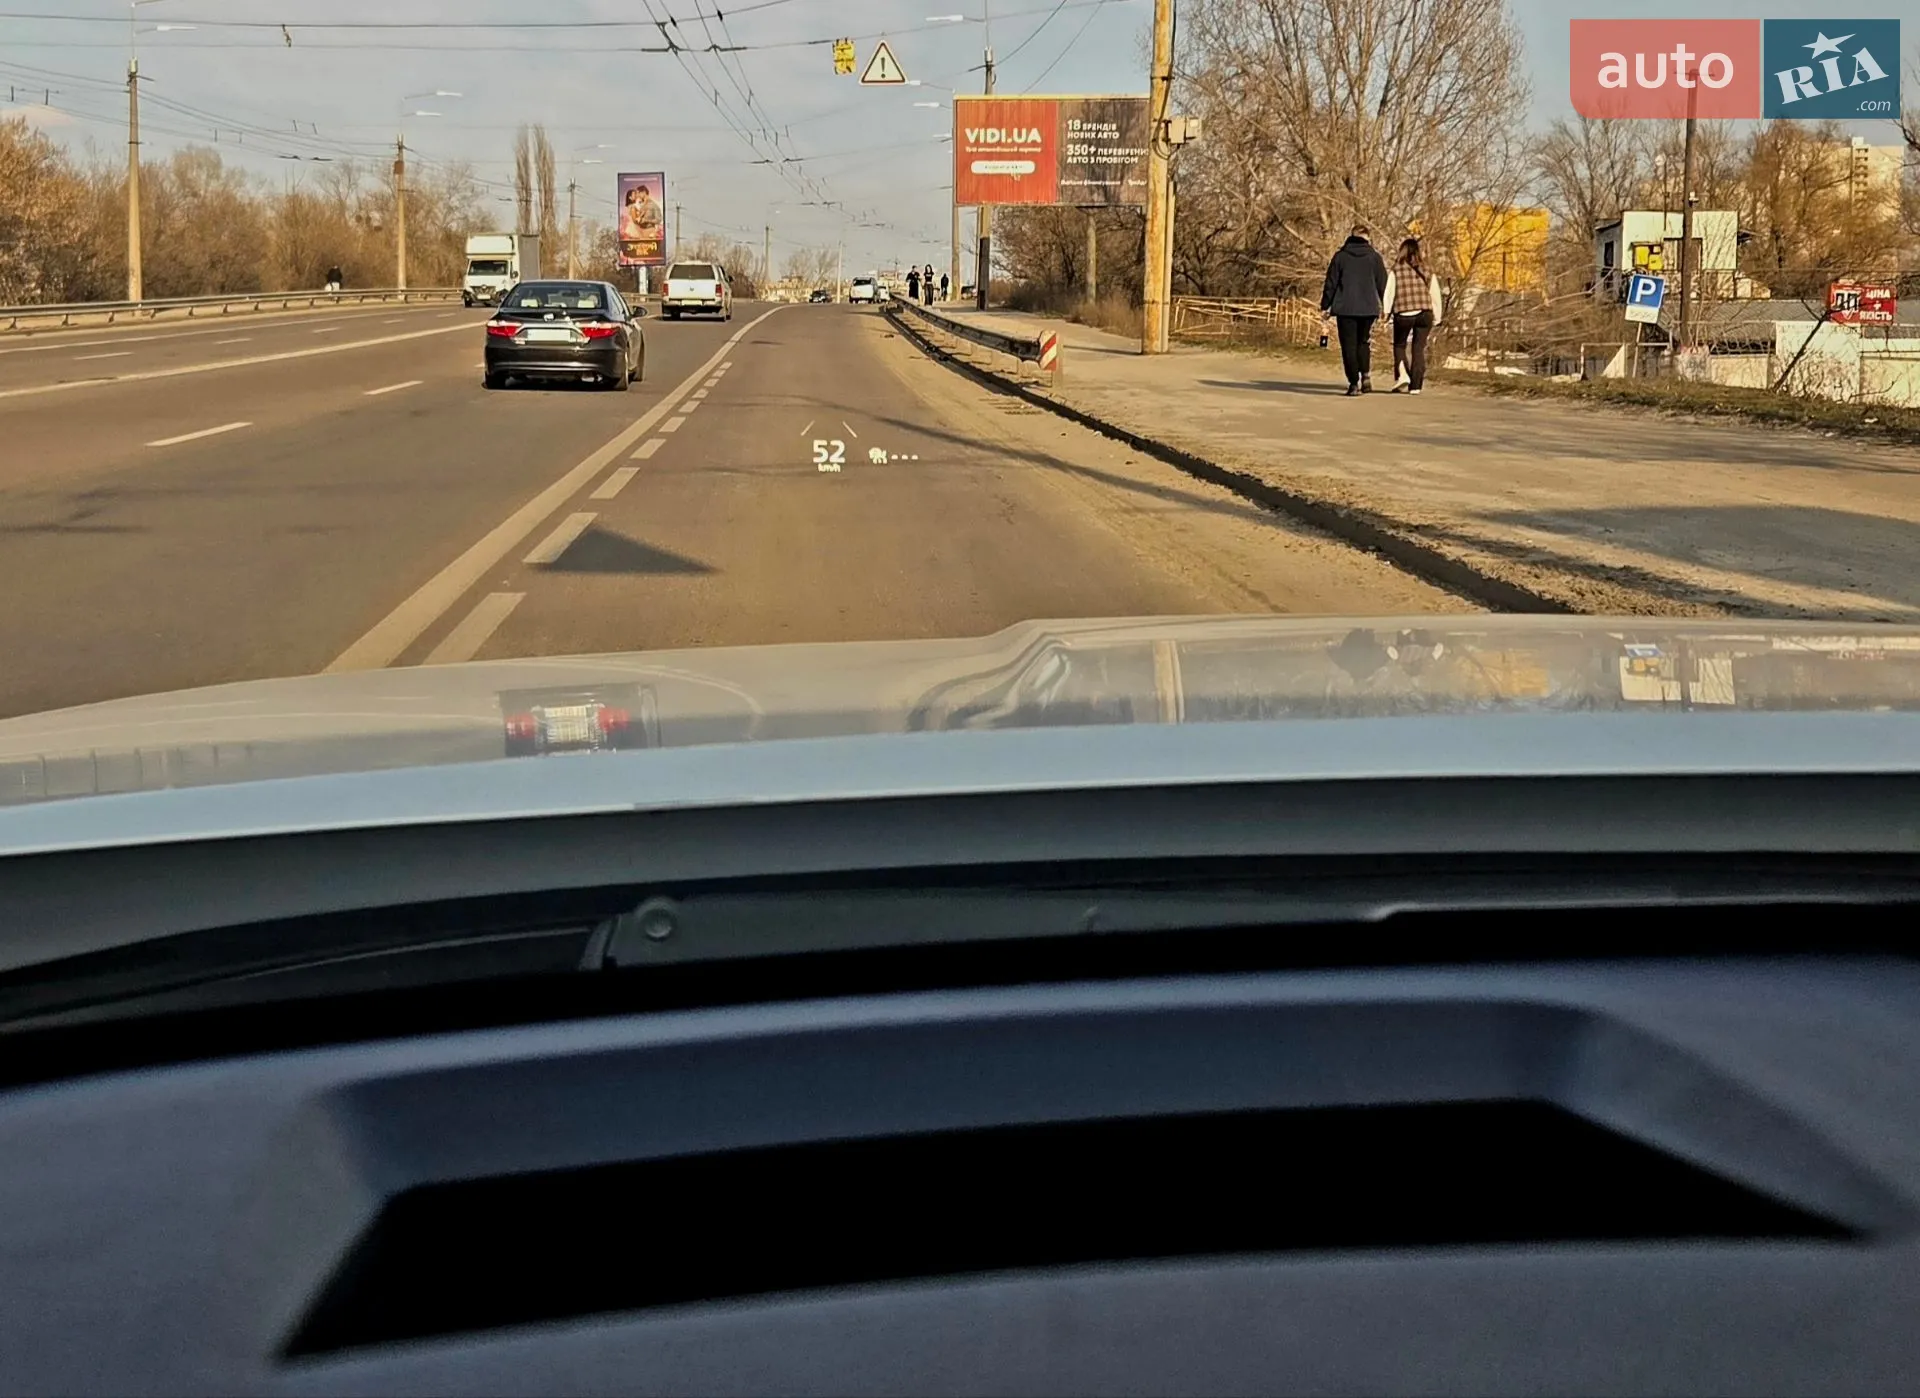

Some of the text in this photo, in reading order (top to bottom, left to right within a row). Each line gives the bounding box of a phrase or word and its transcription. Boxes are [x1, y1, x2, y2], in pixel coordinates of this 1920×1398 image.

[1067, 119, 1081, 131] 18
[964, 128, 1042, 144] VIDI.UA
[1097, 131, 1120, 139] АВТО
[1066, 144, 1096, 156] 350+
[1066, 156, 1089, 164] АВТО
[1635, 279, 1656, 303] P
[1865, 288, 1891, 299] ЦІНА
[1859, 311, 1893, 321] ЯКІСТЬ
[812, 440, 846, 463] 52
